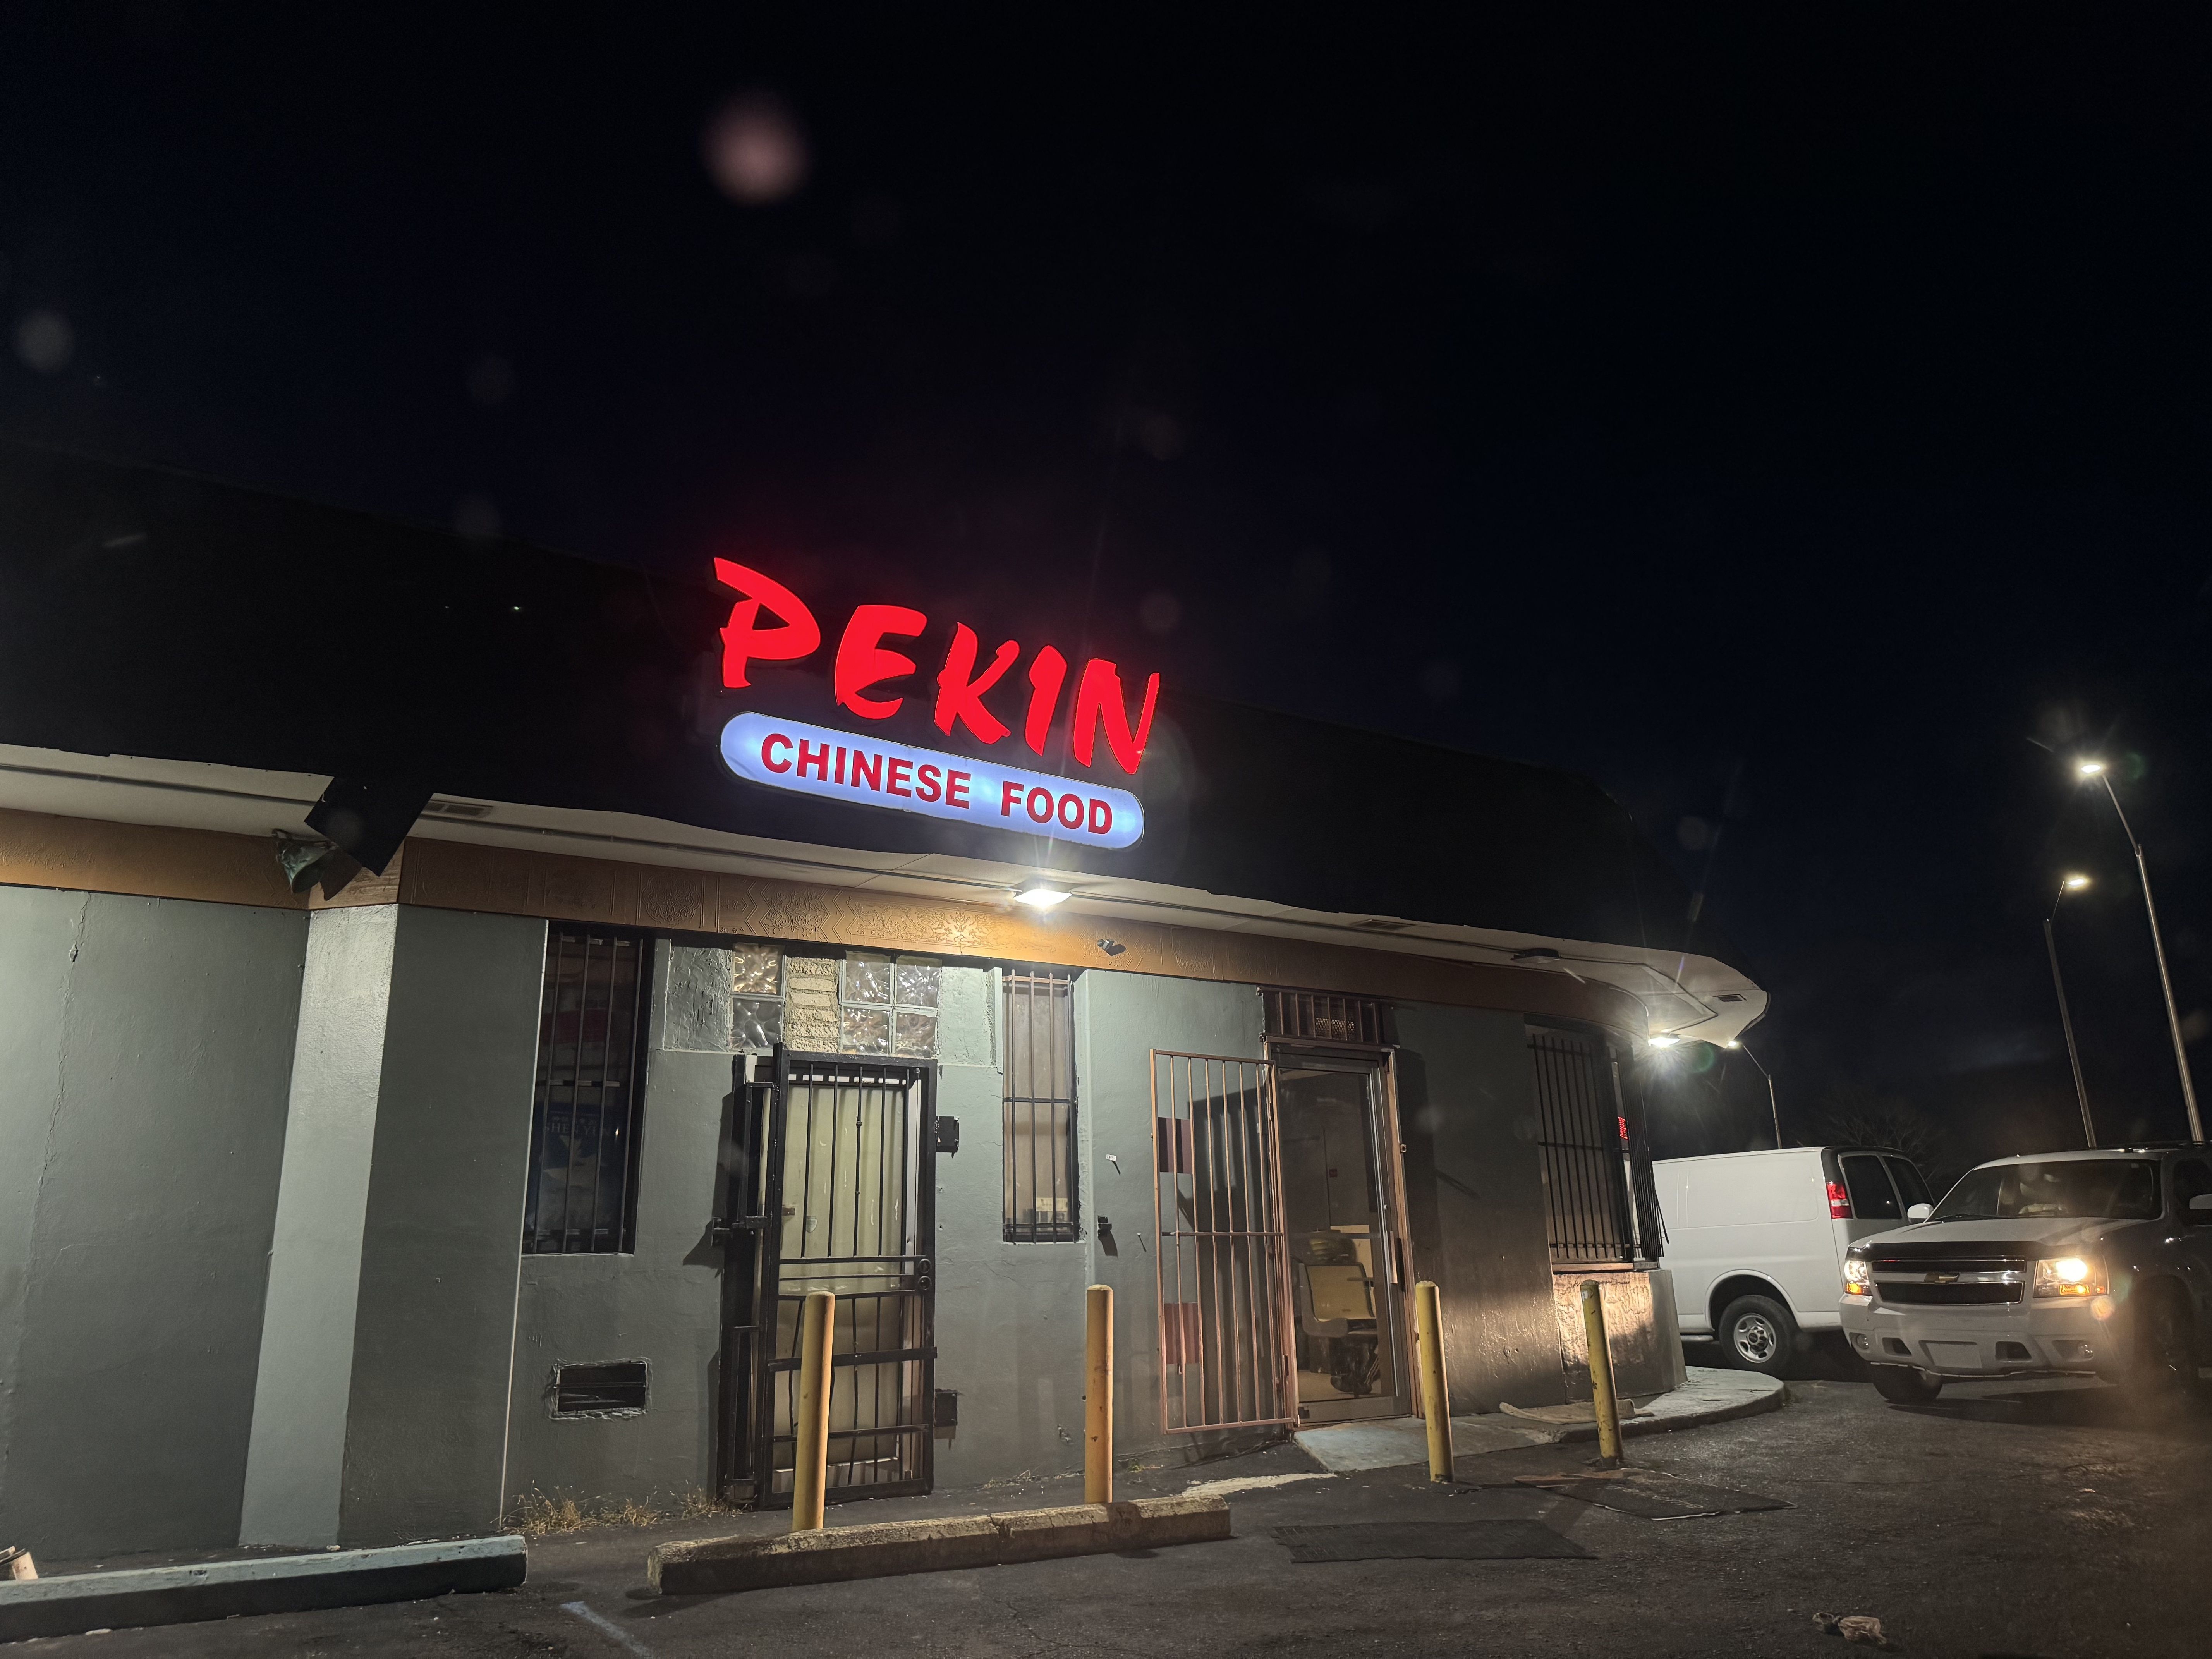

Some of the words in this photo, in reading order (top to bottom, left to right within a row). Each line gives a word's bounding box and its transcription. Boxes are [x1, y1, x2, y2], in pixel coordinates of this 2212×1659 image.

[714, 557, 1160, 775] PEKIN
[761, 733, 971, 809] CHINESE
[1001, 781, 1113, 835] FOOD
